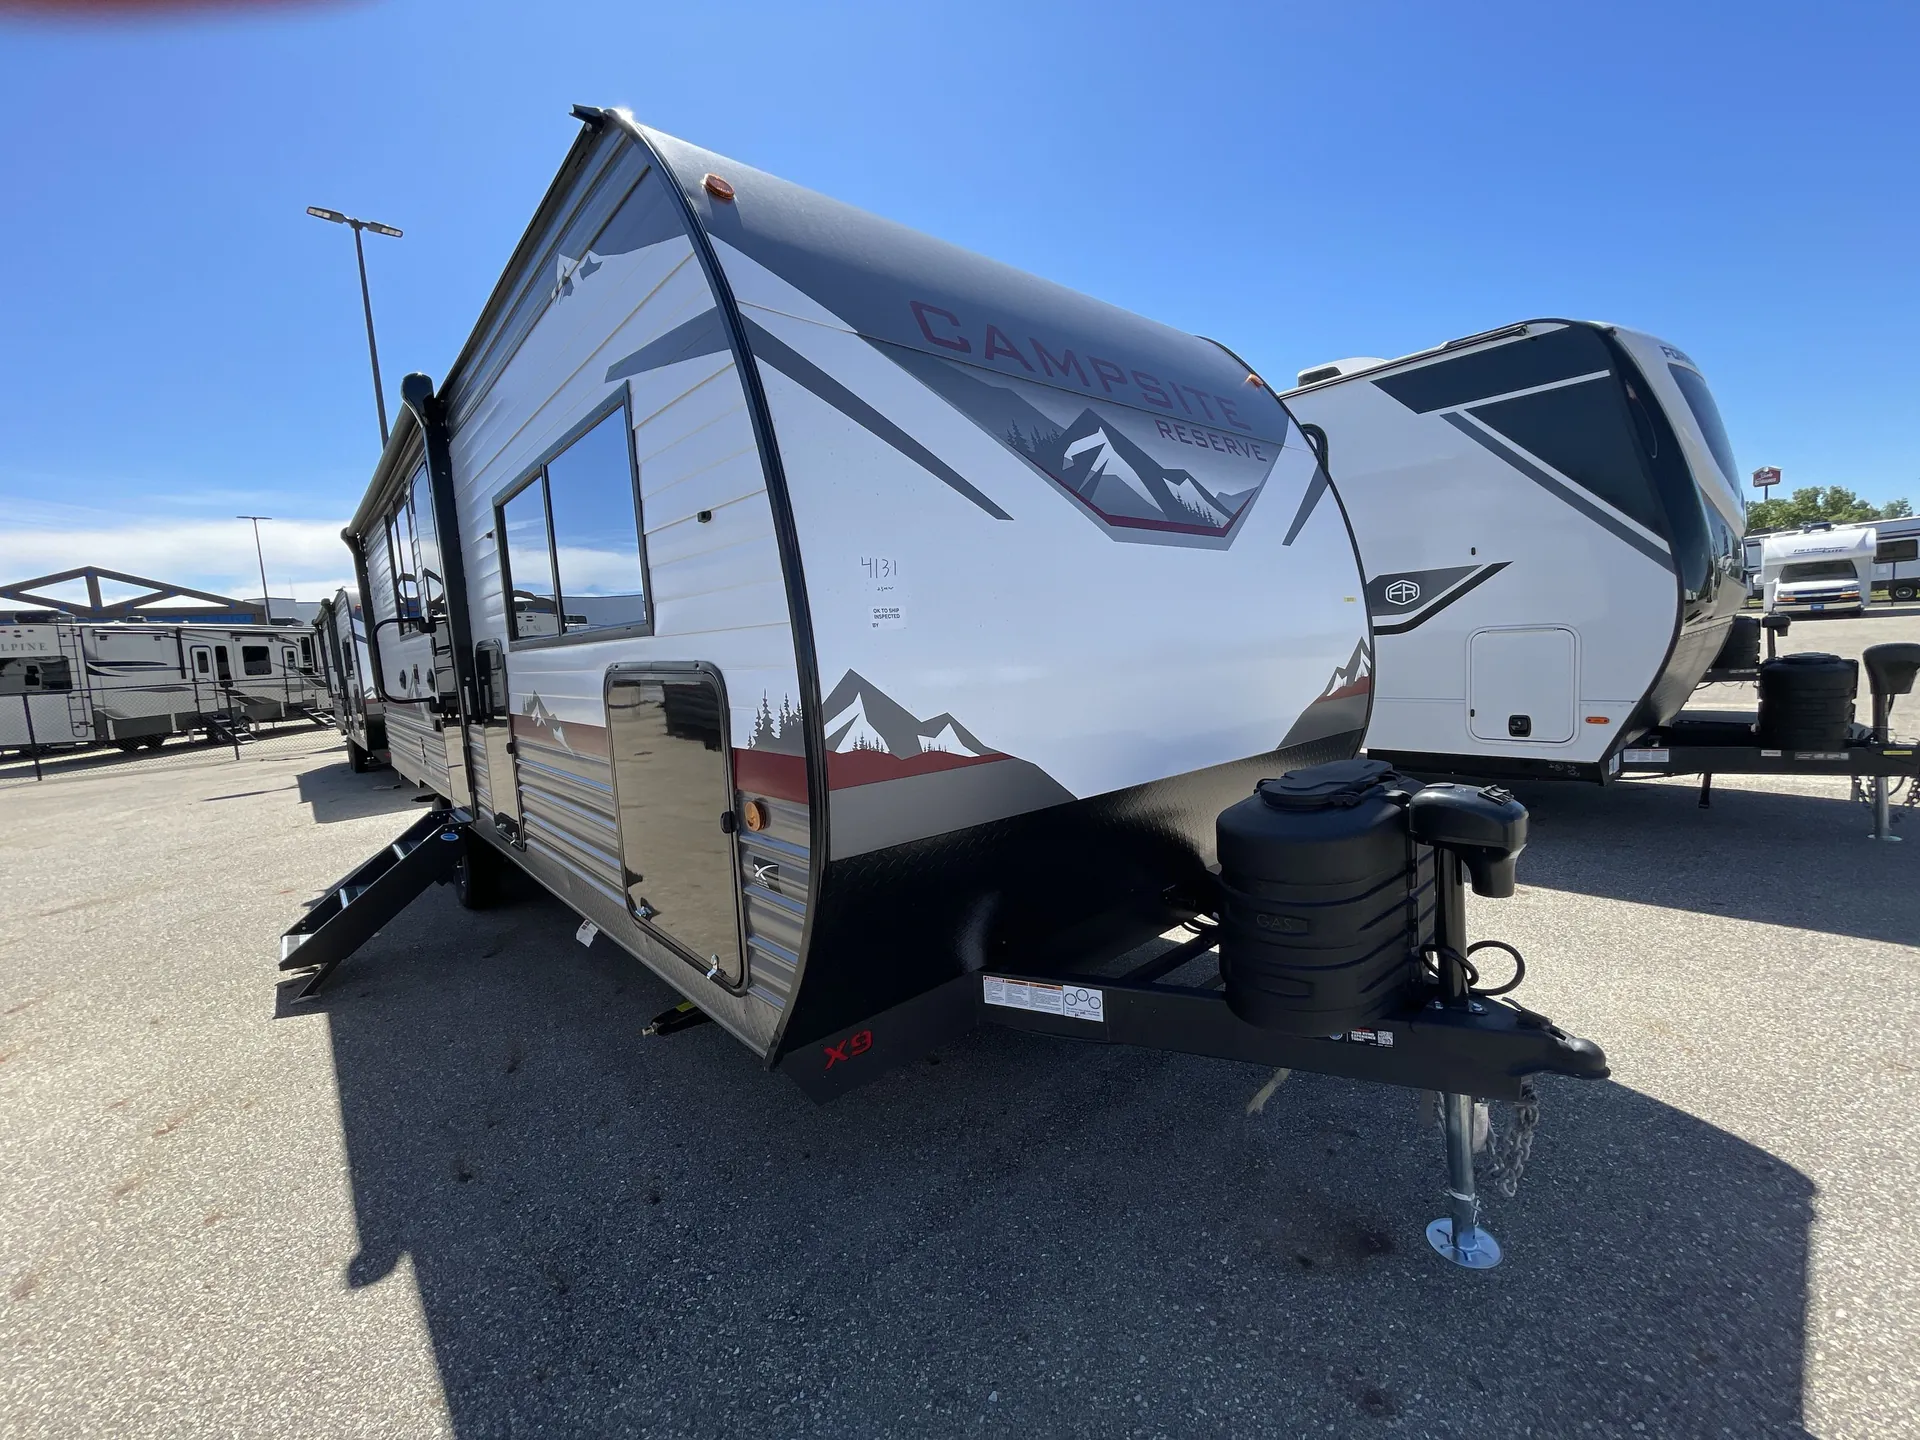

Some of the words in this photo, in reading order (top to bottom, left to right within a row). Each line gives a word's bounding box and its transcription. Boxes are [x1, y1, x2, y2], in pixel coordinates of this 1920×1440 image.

[909, 300, 1252, 431] CAMPSITE
[1154, 419, 1267, 462] RESERVE
[860, 556, 897, 579] 4131
[1389, 583, 1416, 602] FR
[1256, 913, 1292, 931] GAS
[823, 1029, 874, 1072] X9
